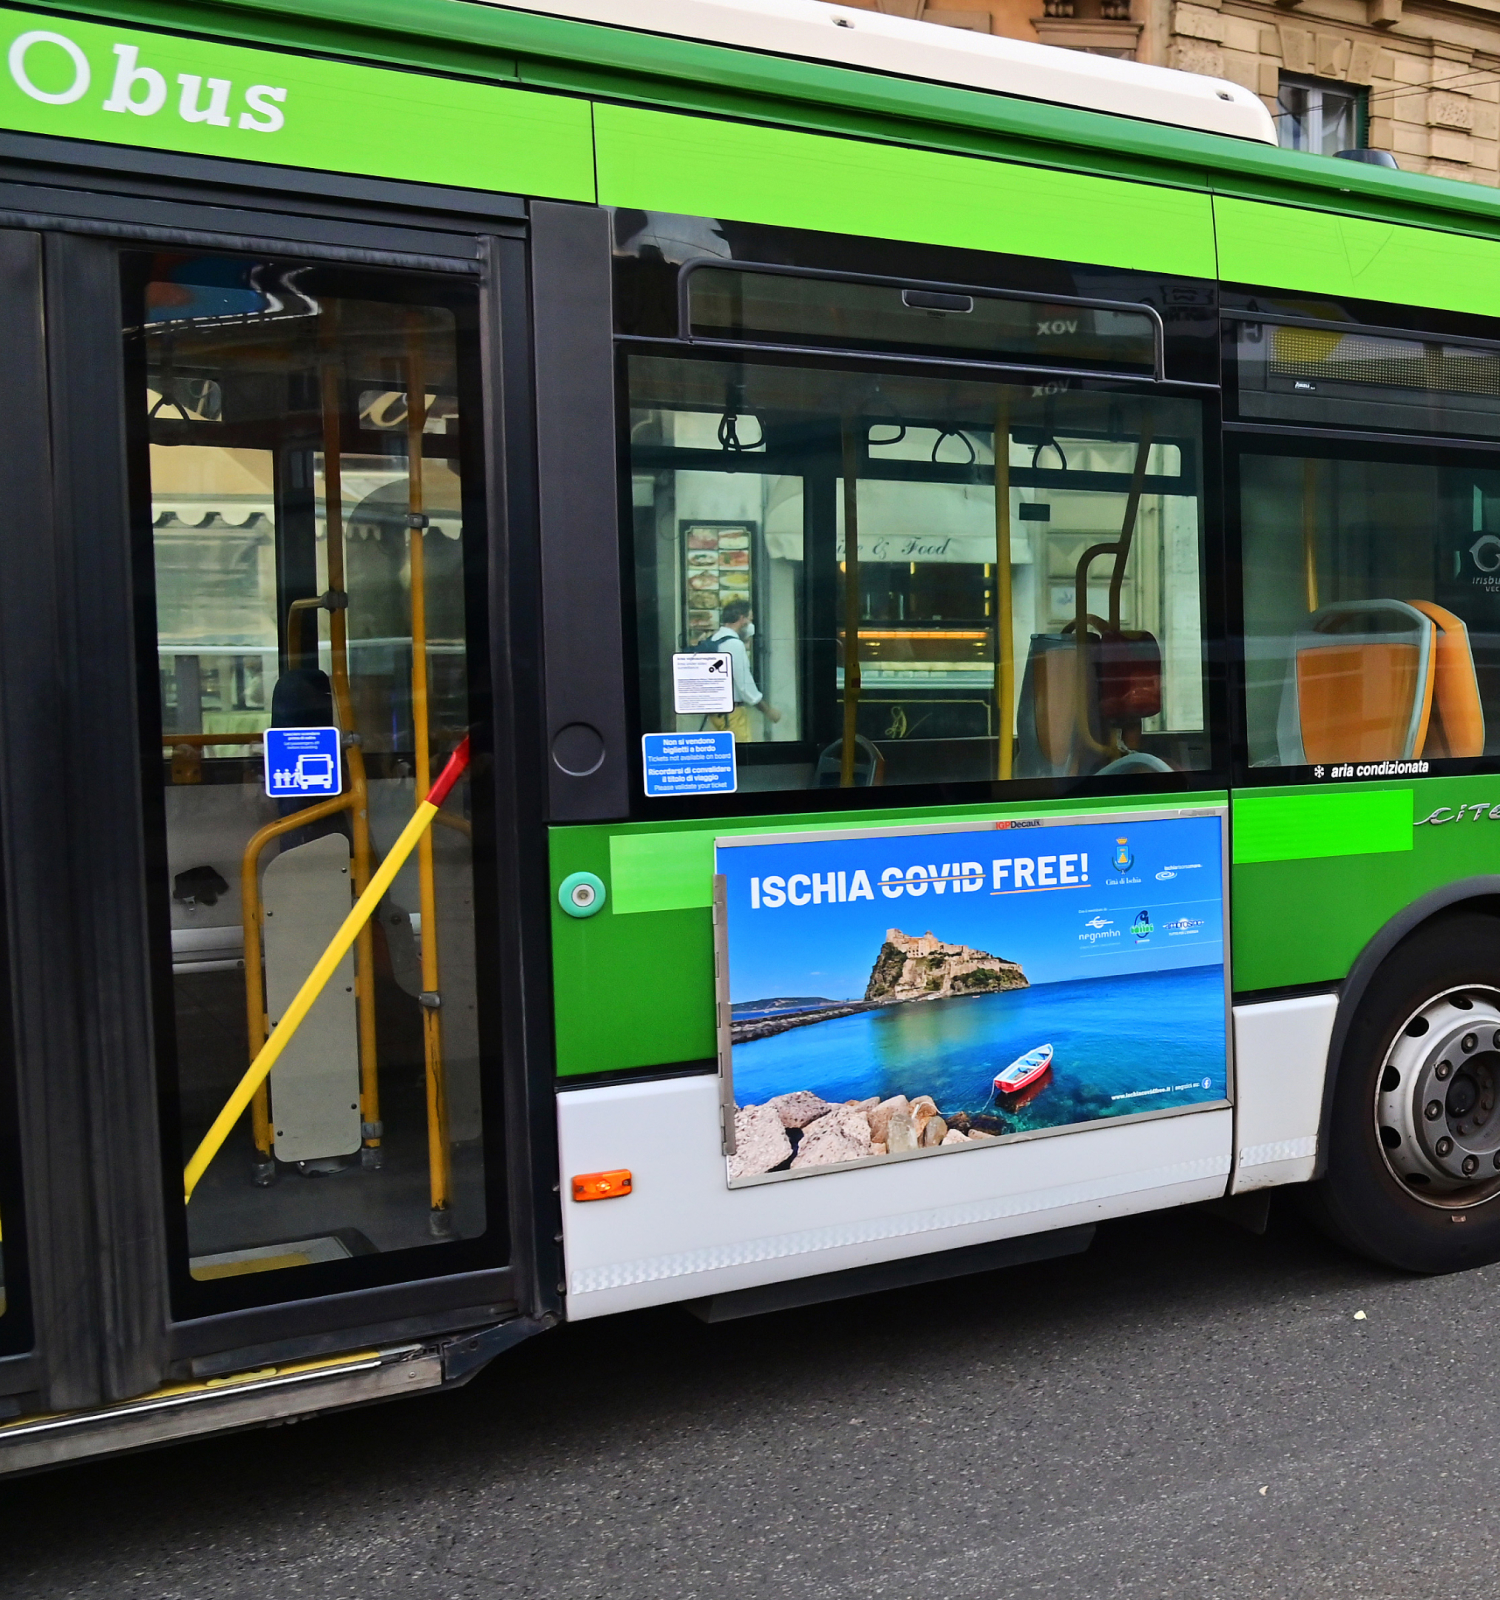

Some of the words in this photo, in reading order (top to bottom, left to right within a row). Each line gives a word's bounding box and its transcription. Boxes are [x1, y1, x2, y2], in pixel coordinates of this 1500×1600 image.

[901, 537, 952, 555] Food
[663, 746, 689, 754] biglietti
[648, 767, 683, 775] Ricordarsi
[1330, 763, 1354, 778] aria
[1356, 760, 1429, 776] condizionata
[694, 774, 719, 782] viaggio
[750, 869, 875, 909] ISCHIA
[880, 861, 984, 899] COVID
[992, 852, 1090, 890] FREE!
[1125, 876, 1142, 884] Ischia
